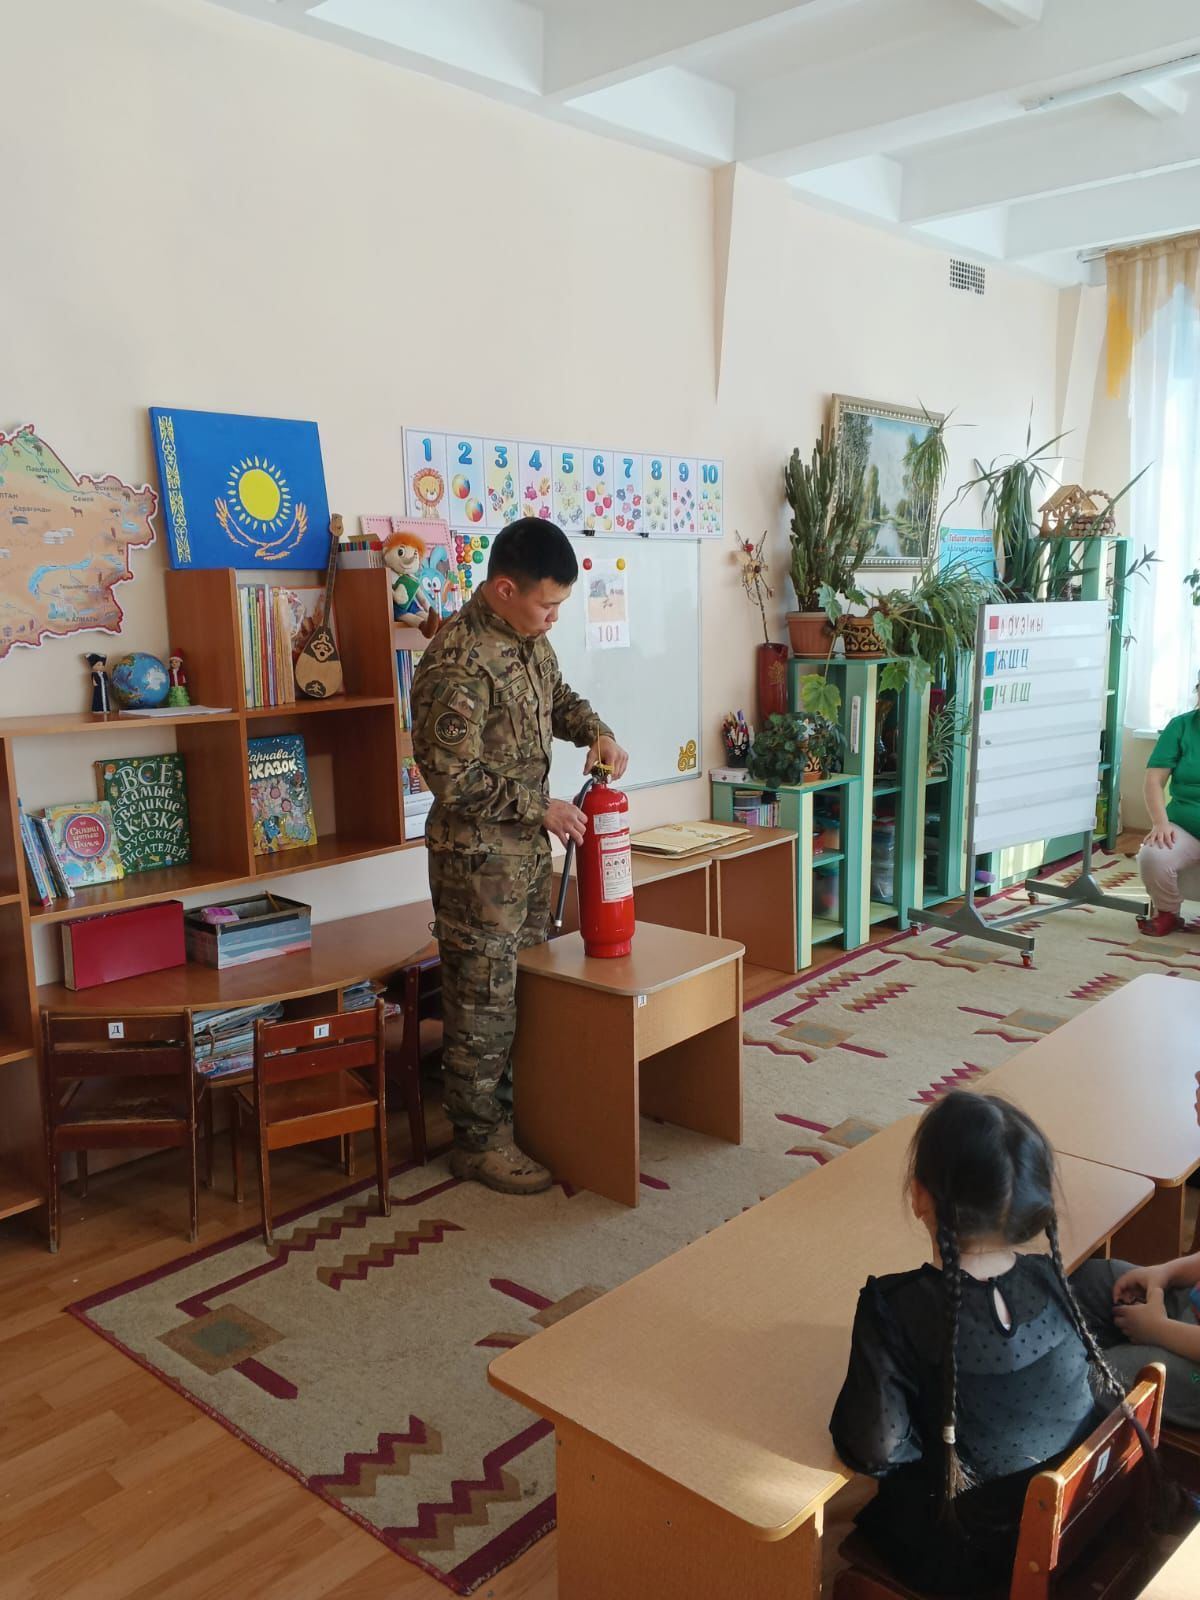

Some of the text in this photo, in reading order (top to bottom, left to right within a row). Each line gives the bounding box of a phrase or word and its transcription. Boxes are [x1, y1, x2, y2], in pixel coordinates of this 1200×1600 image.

[422, 438, 719, 484] 1 2 3 4 5 6 7 8 9 10
[598, 624, 620, 642] 101
[248, 747, 296, 764] арнавал
[116, 761, 173, 792] ВСЕ
